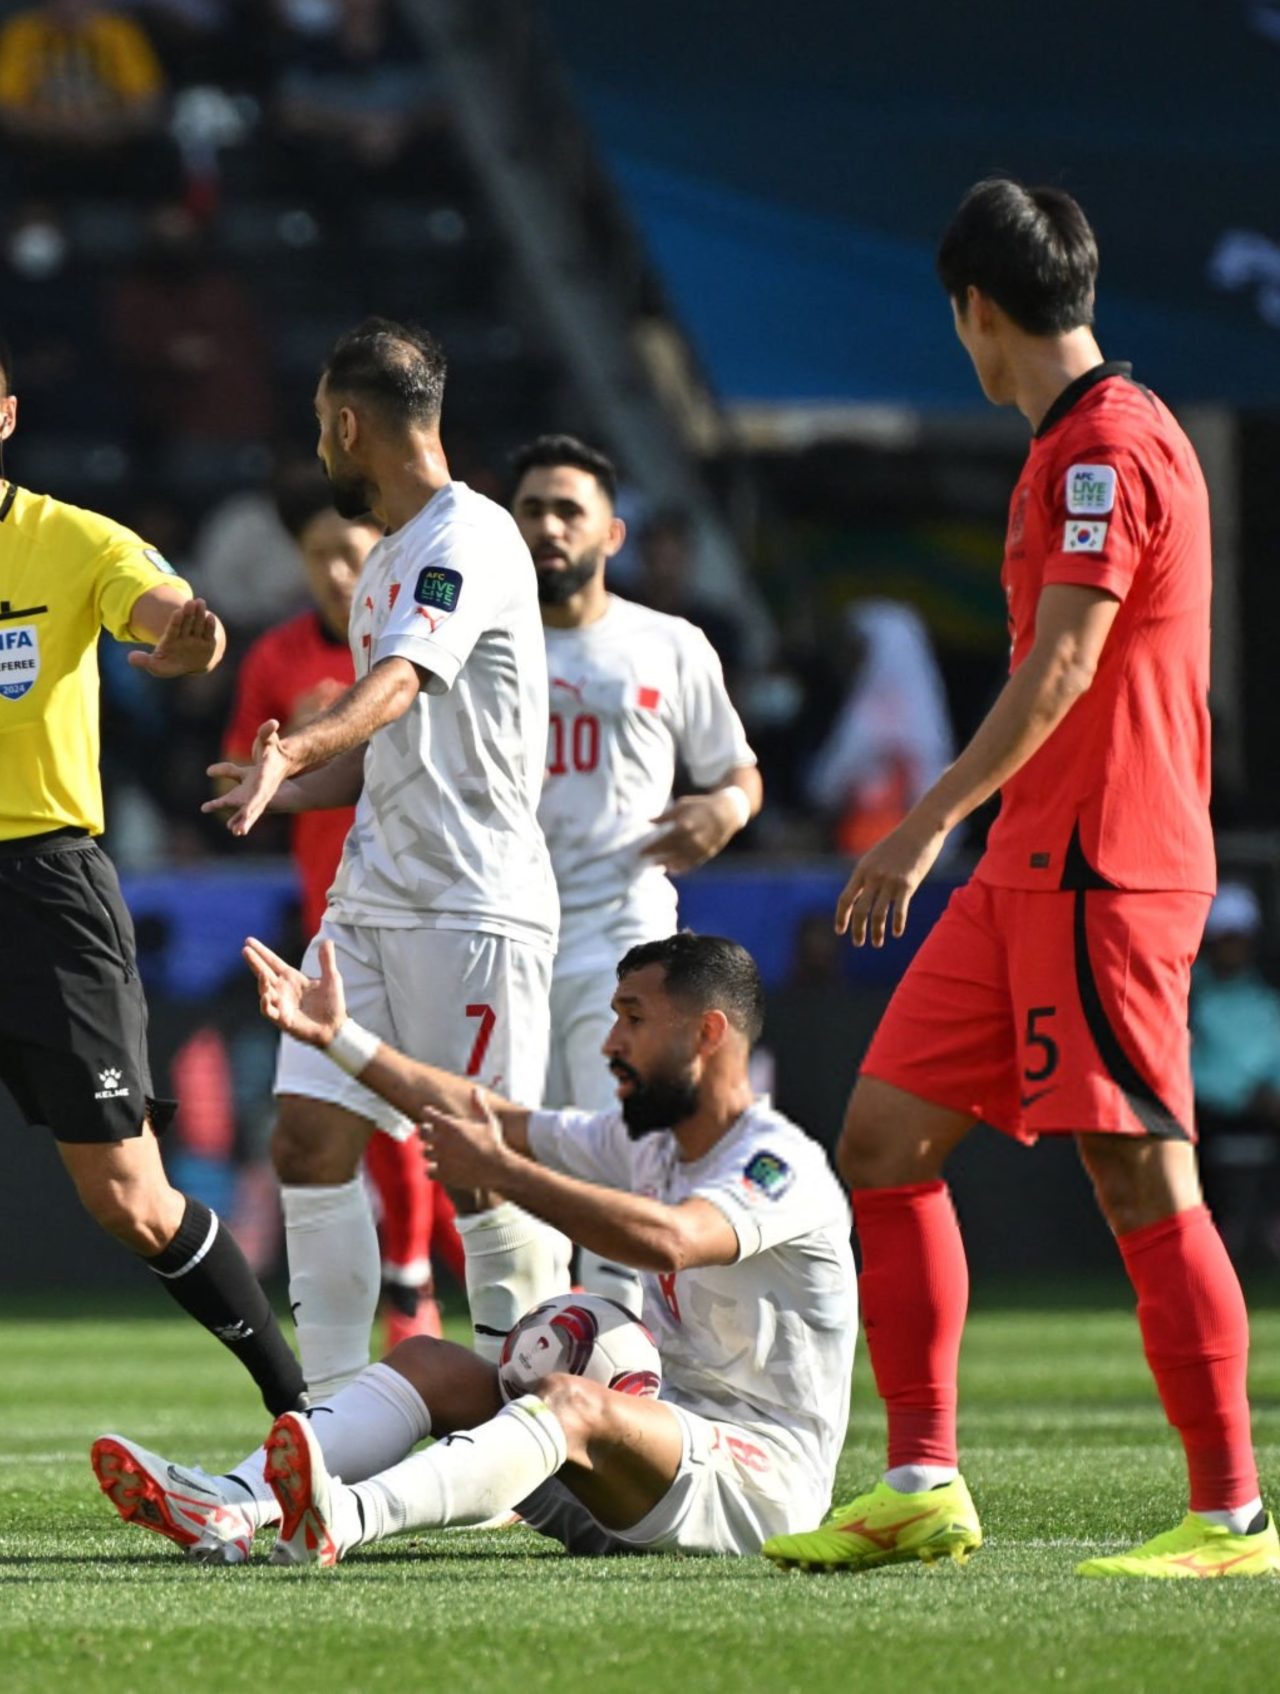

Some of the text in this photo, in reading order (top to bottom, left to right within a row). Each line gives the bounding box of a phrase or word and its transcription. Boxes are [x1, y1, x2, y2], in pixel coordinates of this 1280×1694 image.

[1074, 472, 1094, 480] AFC
[1072, 481, 1107, 494] LIVE
[425, 571, 446, 581] AFC
[423, 579, 456, 596] LIVE
[2, 684, 26, 696] 2024
[549, 713, 601, 775] 10
[465, 1004, 496, 1076] 7
[1024, 1006, 1059, 1081] 5
[94, 1088, 130, 1099] KELME
